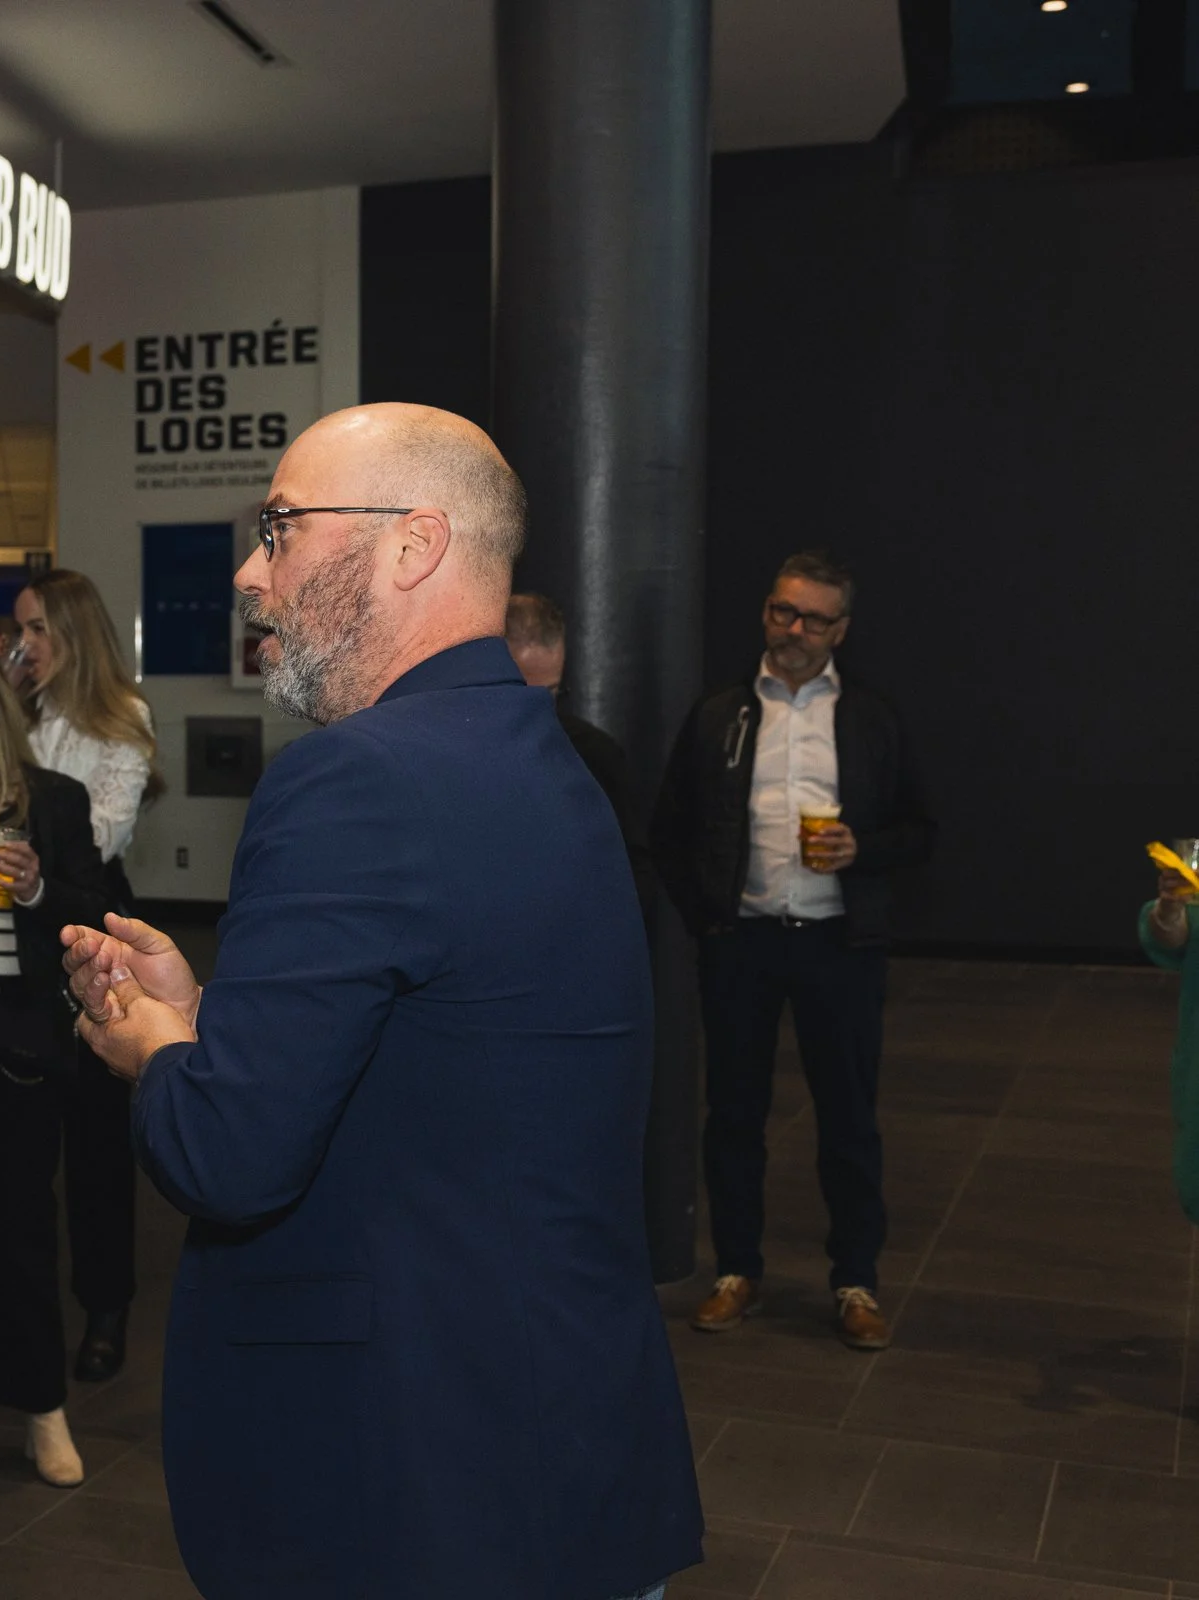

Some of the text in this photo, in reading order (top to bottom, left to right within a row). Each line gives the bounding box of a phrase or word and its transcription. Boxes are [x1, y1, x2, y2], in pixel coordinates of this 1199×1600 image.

[15, 172, 72, 301] BUD
[135, 318, 319, 374] ENTRÉE
[135, 374, 227, 414] DES
[135, 412, 288, 455] LOGES
